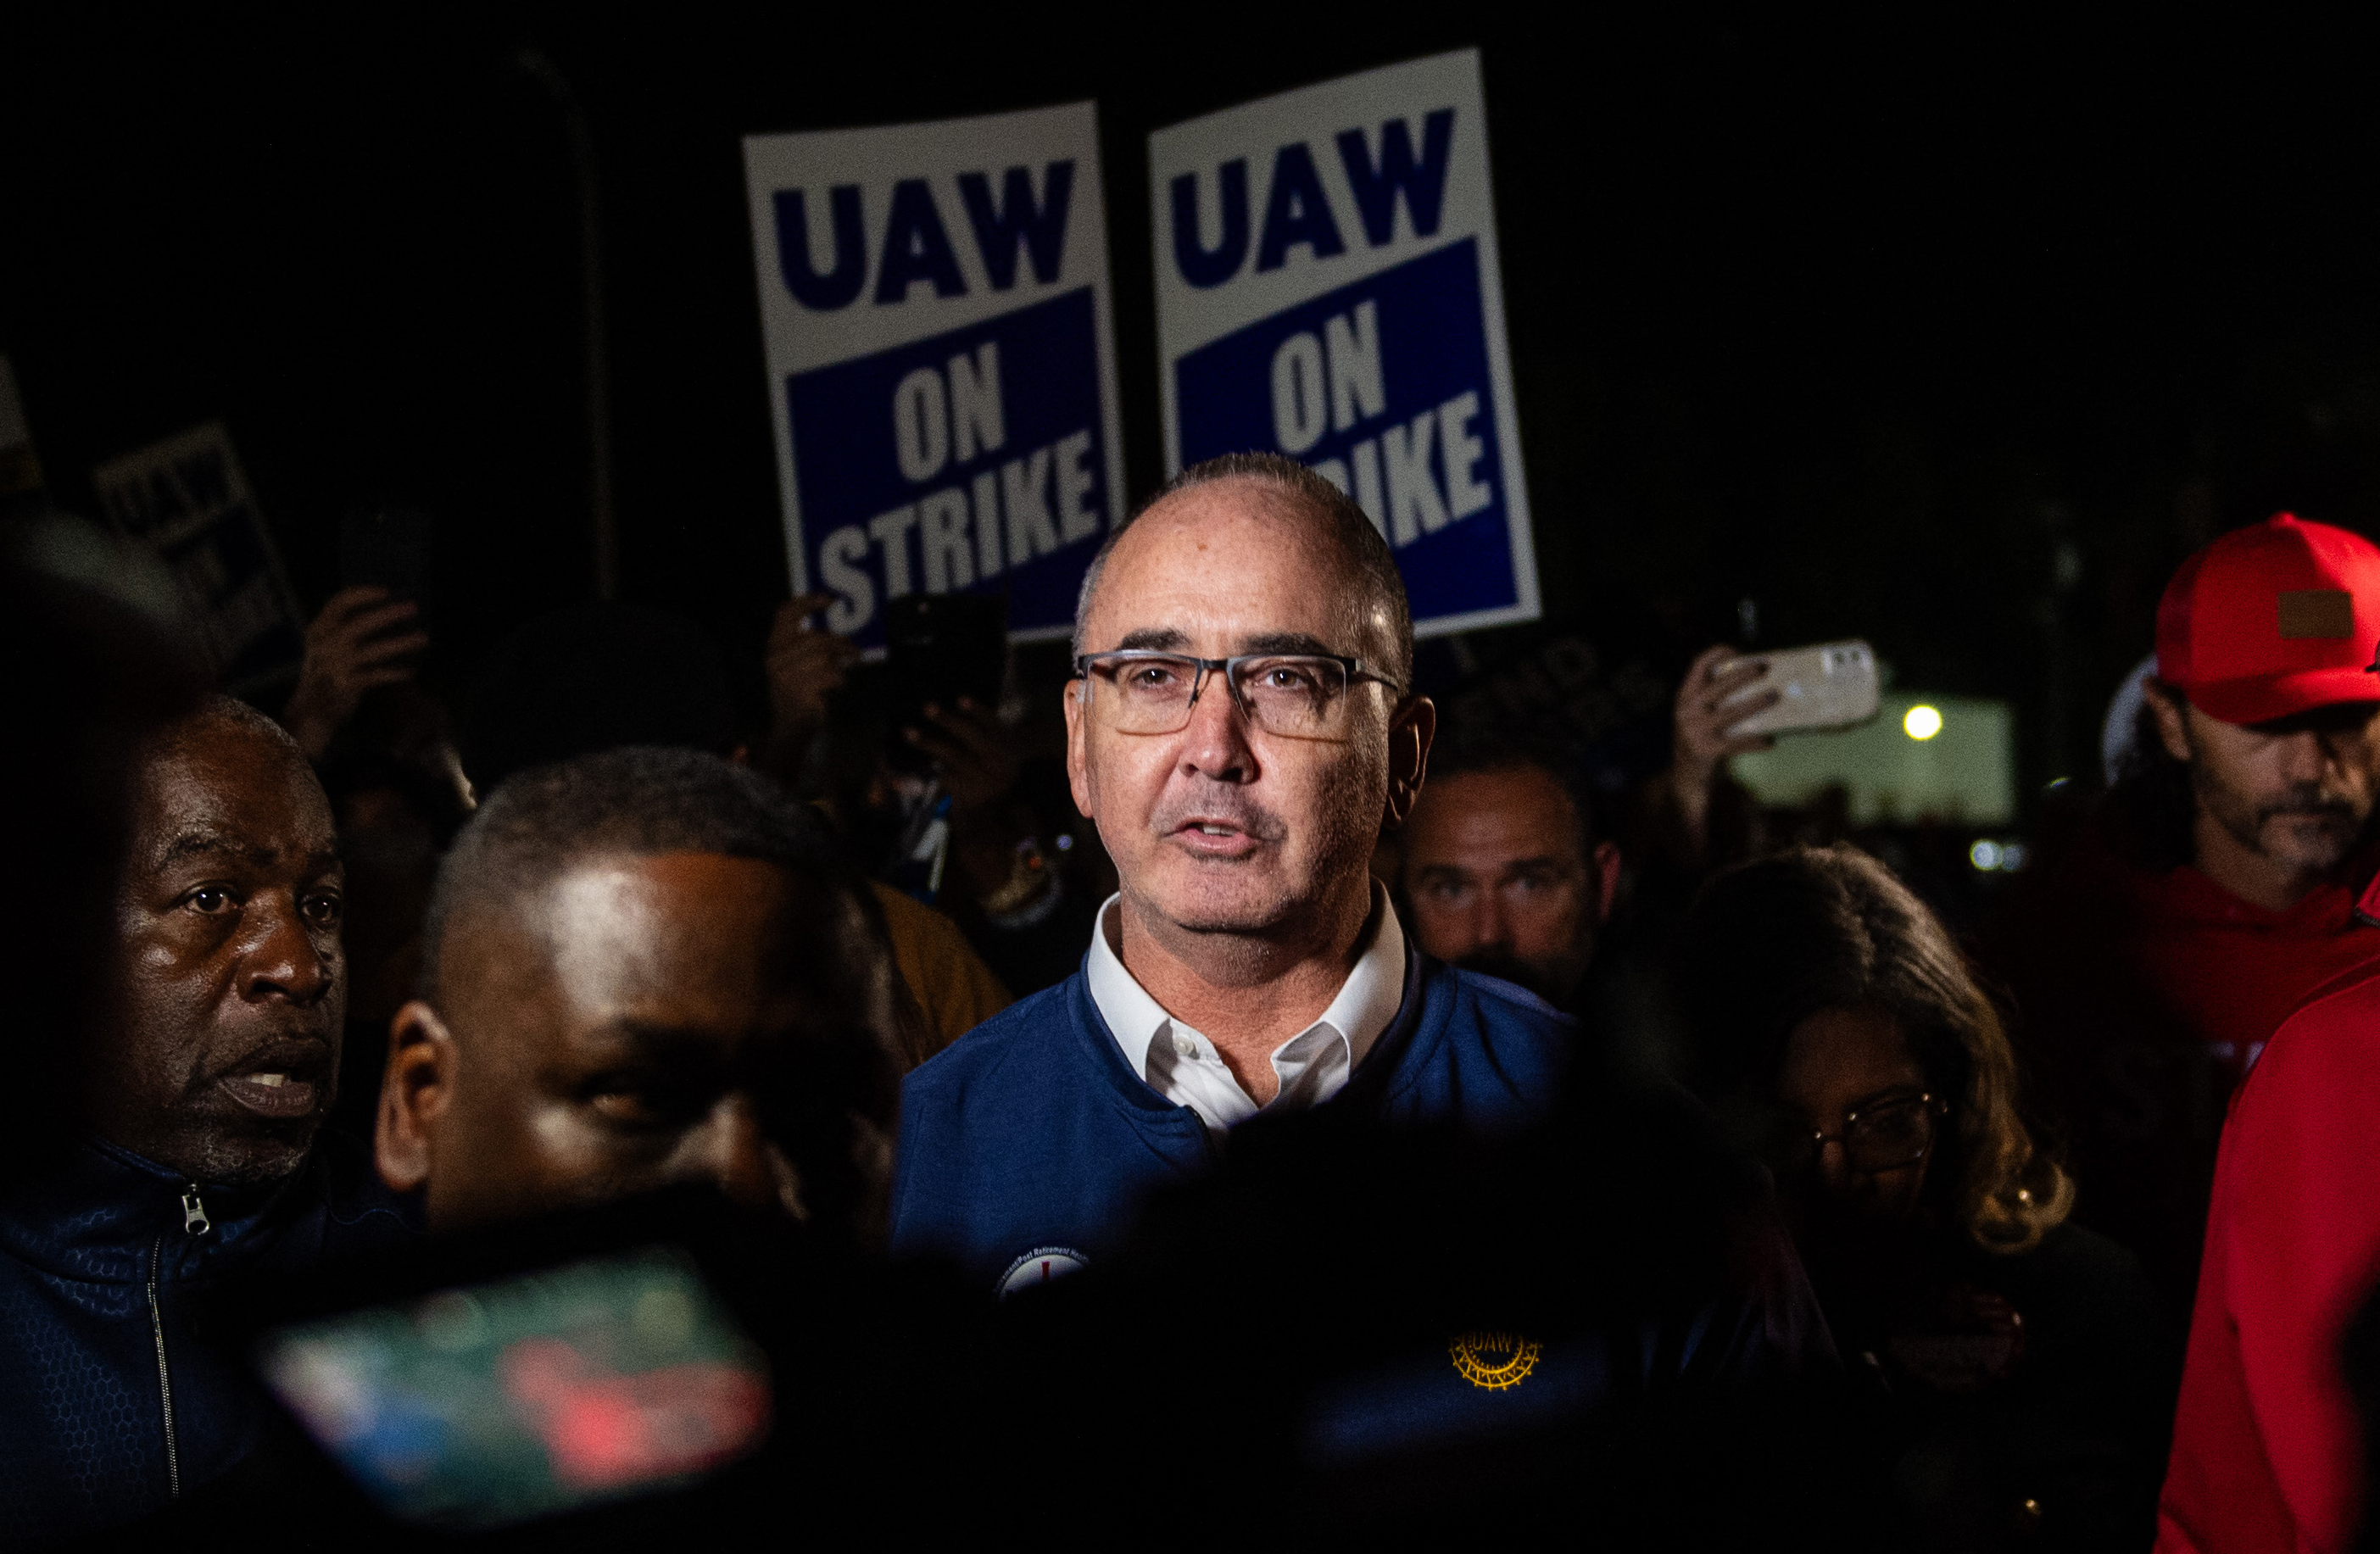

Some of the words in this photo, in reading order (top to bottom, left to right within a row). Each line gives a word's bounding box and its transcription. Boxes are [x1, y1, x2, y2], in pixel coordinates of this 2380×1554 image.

[774, 160, 1075, 311] UAW
[1171, 108, 1453, 289] UAW
[892, 340, 1007, 484] ON
[1269, 296, 1387, 456] ON
[110, 448, 228, 536] UAW
[818, 427, 1101, 637] STRIKE
[1307, 387, 1494, 549] IKE
[1473, 1330, 1513, 1353] UAW
